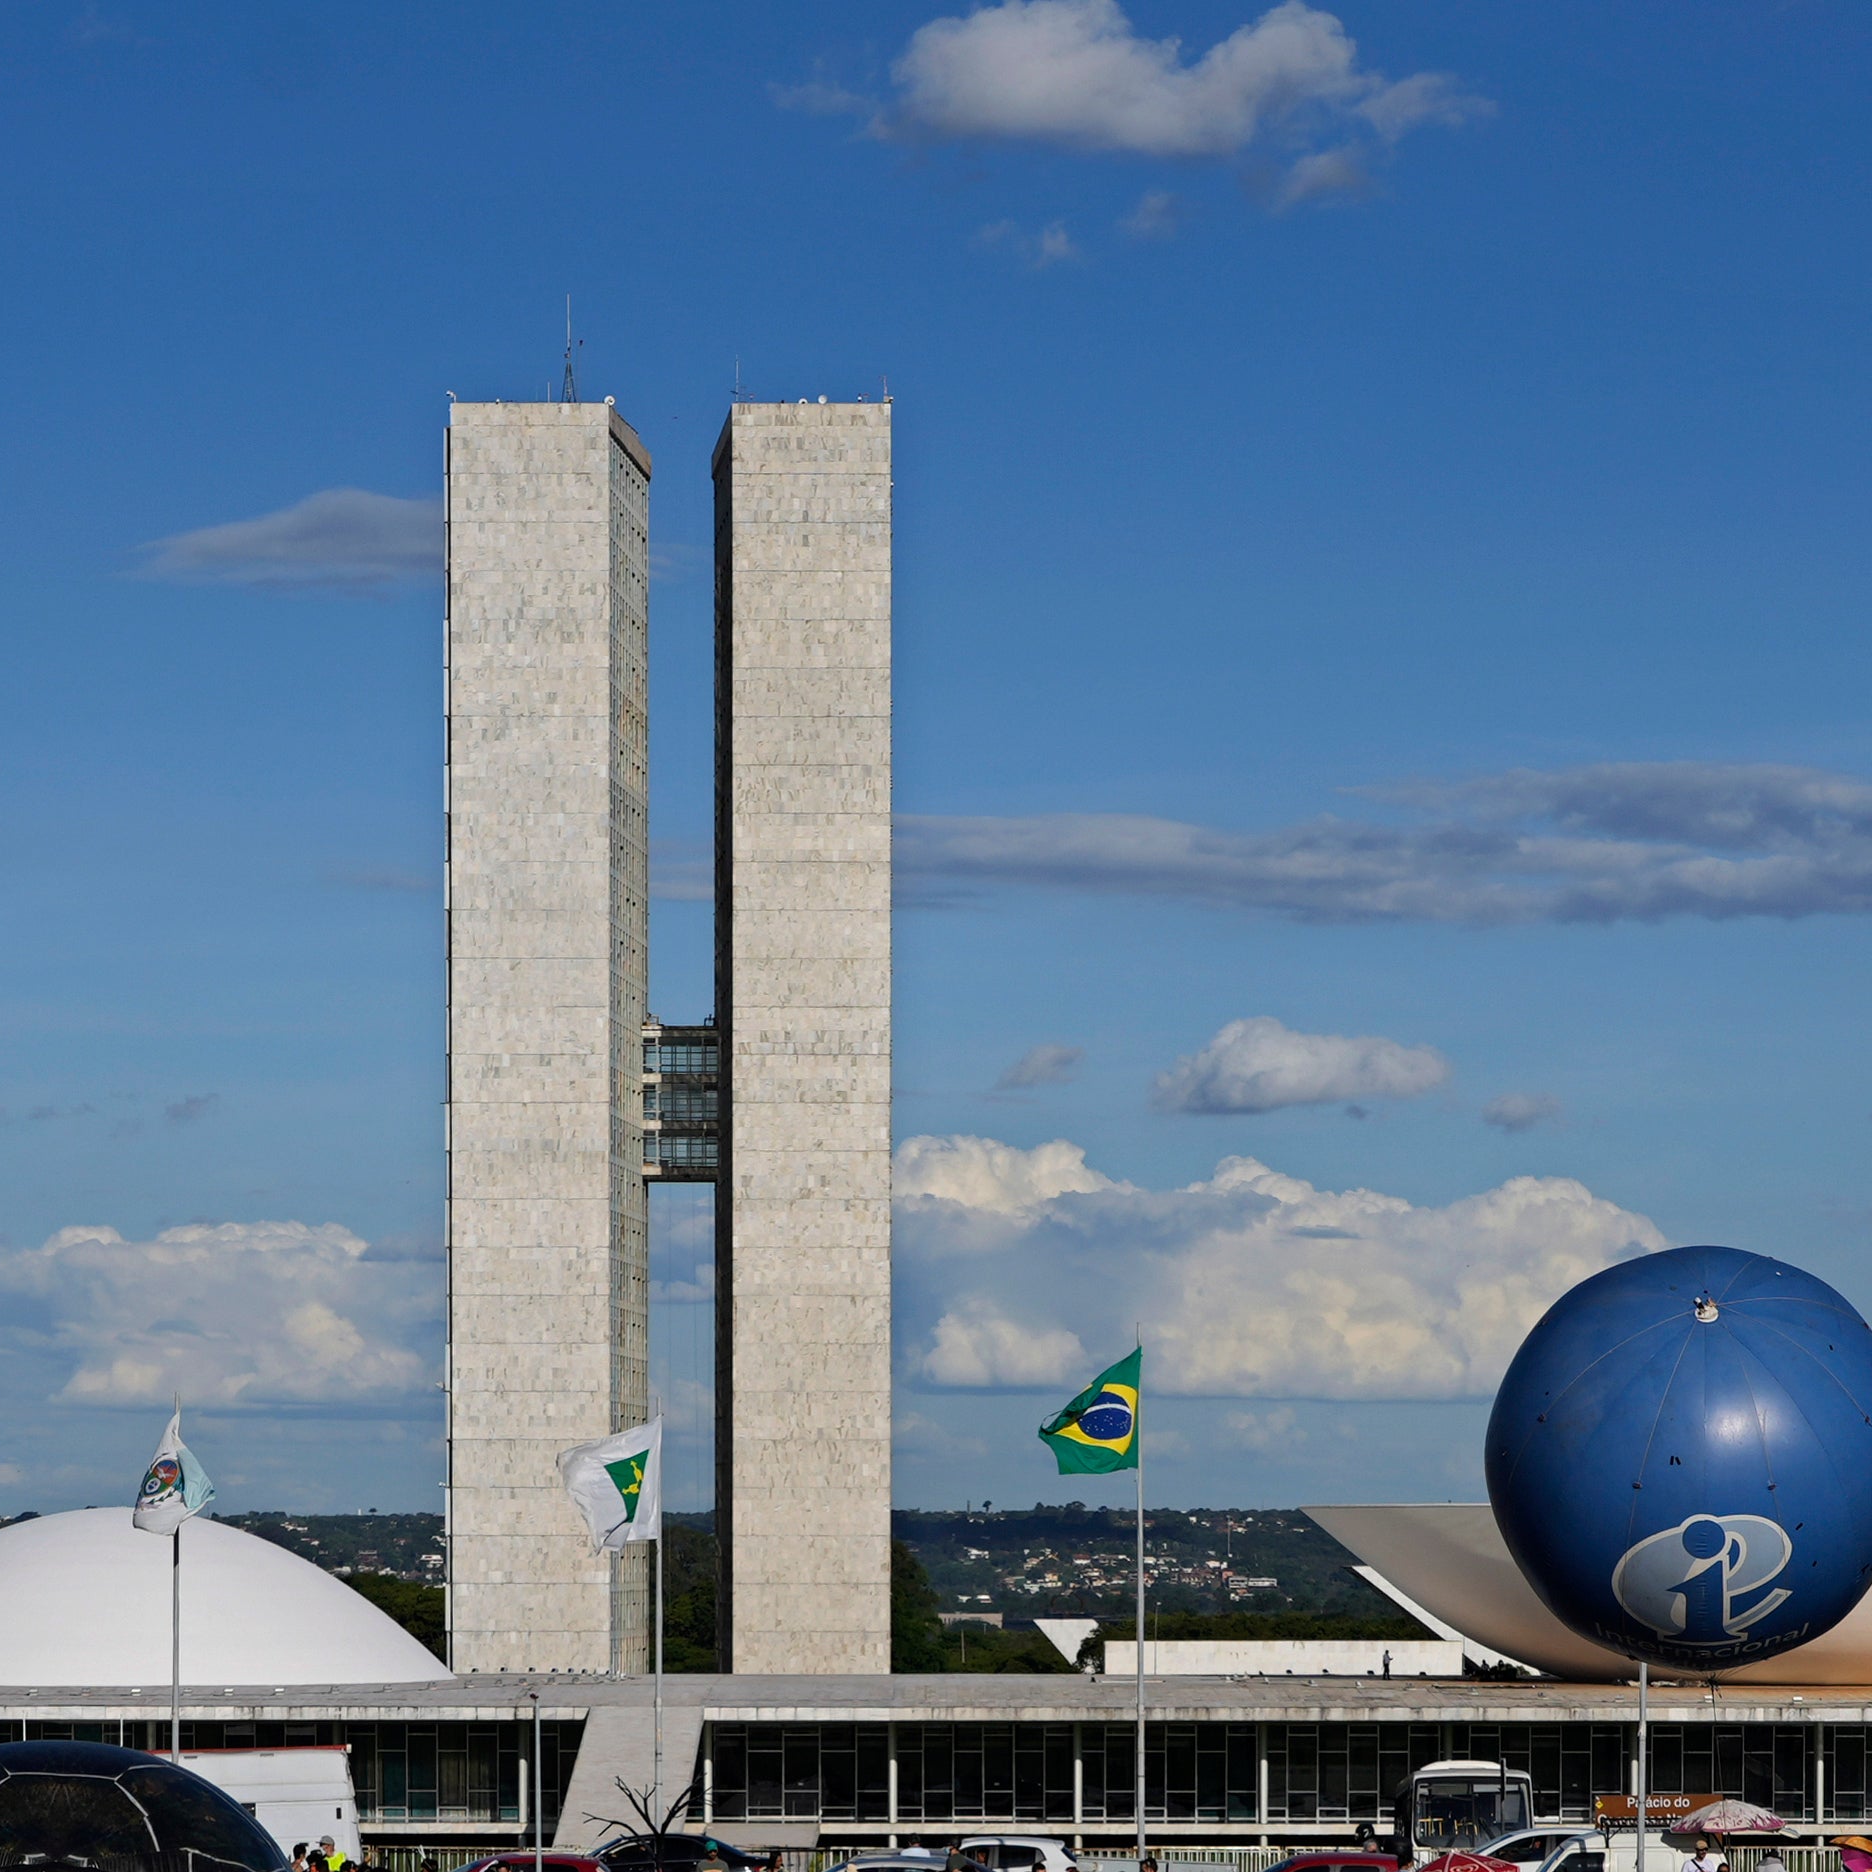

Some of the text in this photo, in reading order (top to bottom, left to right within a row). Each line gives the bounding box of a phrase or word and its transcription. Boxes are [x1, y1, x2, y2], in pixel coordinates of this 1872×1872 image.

[1595, 1622, 1810, 1658] Internacional
[1626, 1796, 1690, 1808] Paácio do
